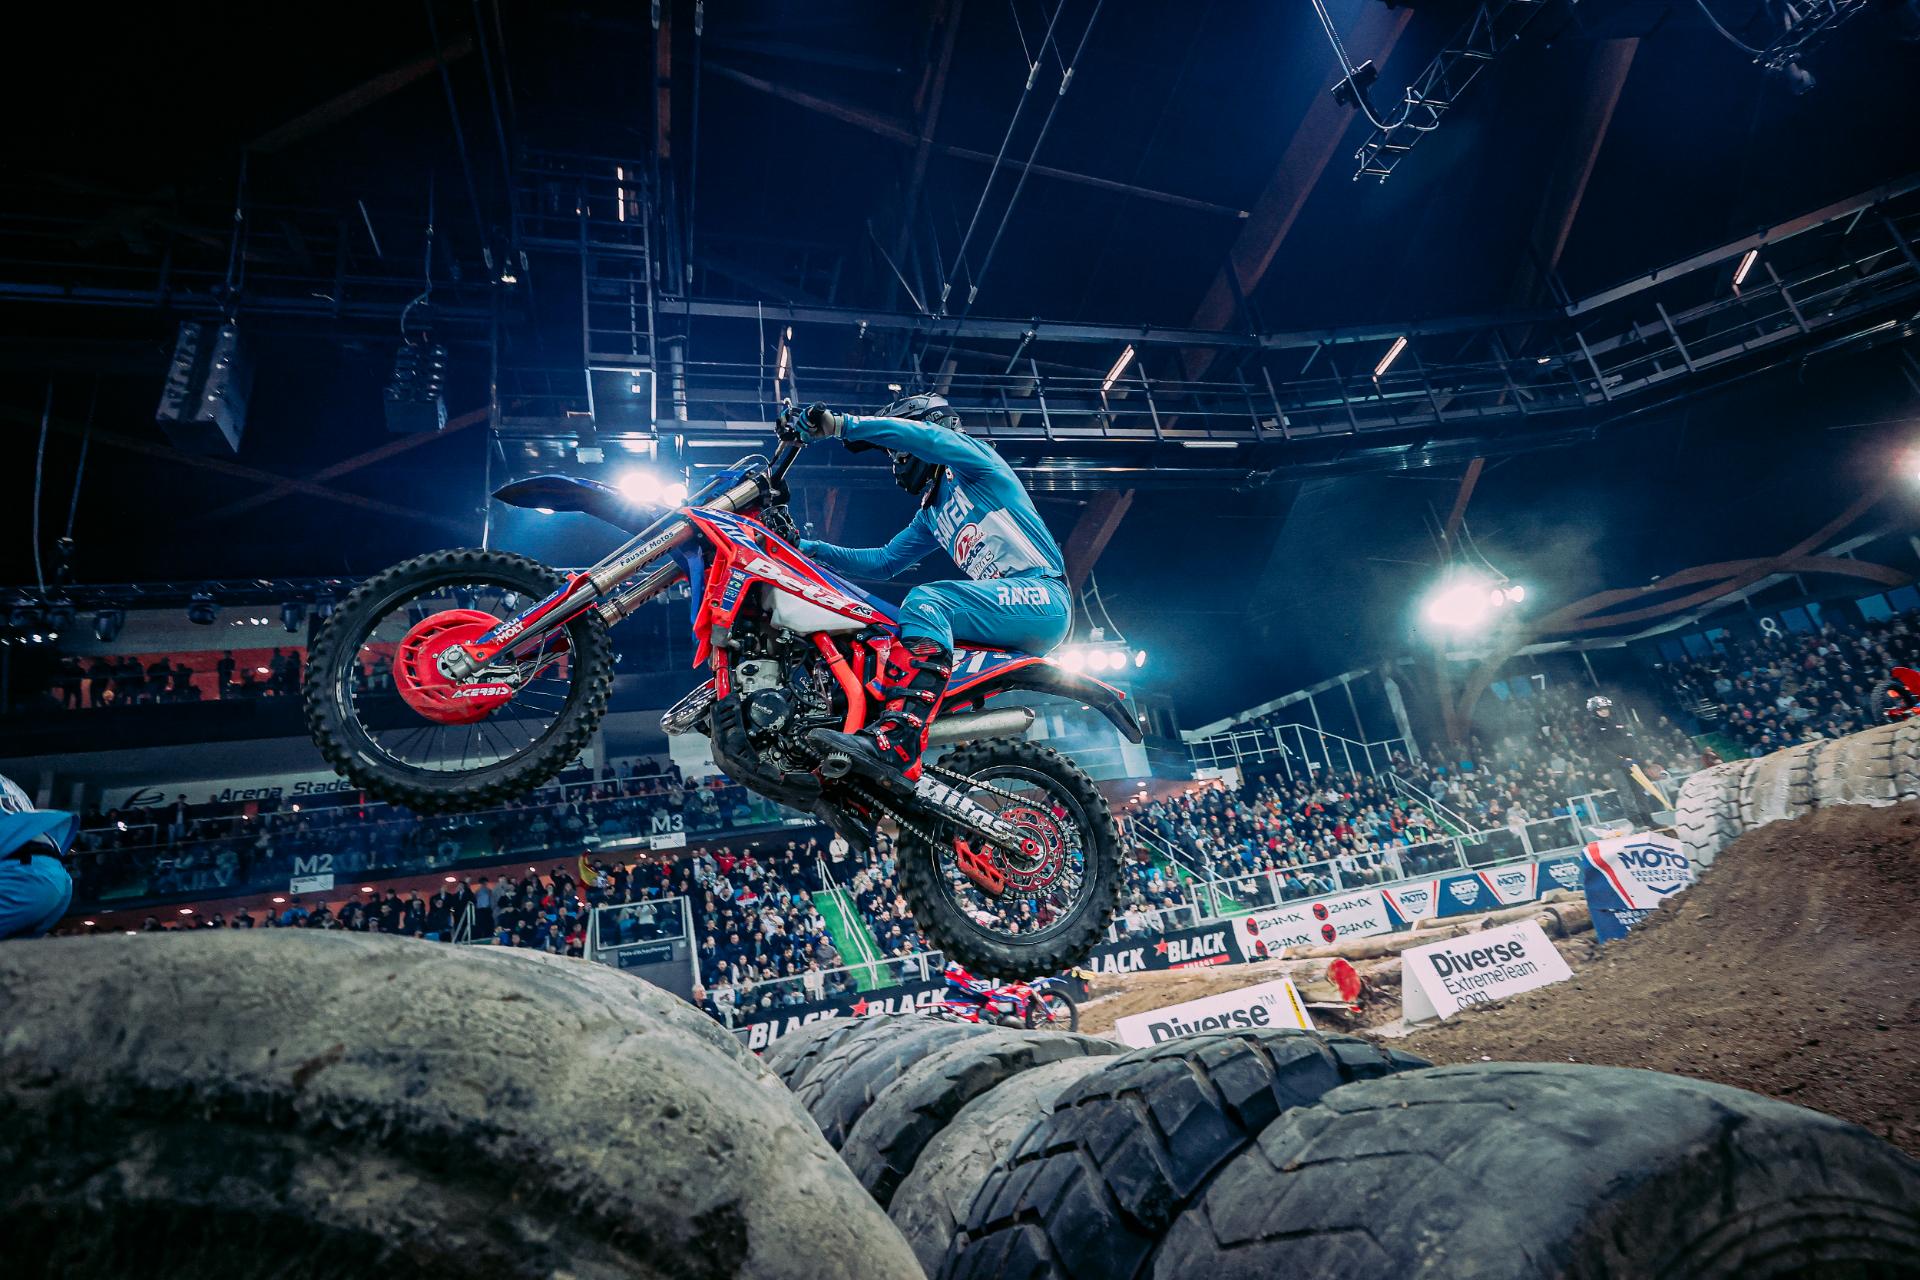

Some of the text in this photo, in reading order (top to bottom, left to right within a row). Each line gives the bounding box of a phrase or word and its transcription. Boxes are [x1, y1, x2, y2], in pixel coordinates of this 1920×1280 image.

[620, 547, 647, 567] Fauser
[650, 531, 674, 549] Motos
[745, 557, 849, 610] Beta
[997, 586, 1050, 606] RAVEN
[493, 617, 520, 636] LIQUI
[499, 622, 525, 643] MOLY
[218, 779, 350, 801] Arena Stade
[651, 814, 684, 833] M3
[294, 853, 333, 876] M2
[1618, 848, 1689, 869] MOTO
[1400, 891, 1428, 904] MOTO
[1259, 897, 1373, 930] 24MX 24MX
[1267, 918, 1378, 951] 24MX 24MX
[1090, 947, 1147, 973] LACK
[1167, 931, 1227, 963] BLACK
[1429, 940, 1526, 977] Diverse
[1442, 960, 1539, 995] ExtremeTeam
[1148, 1005, 1270, 1045] Diverse
